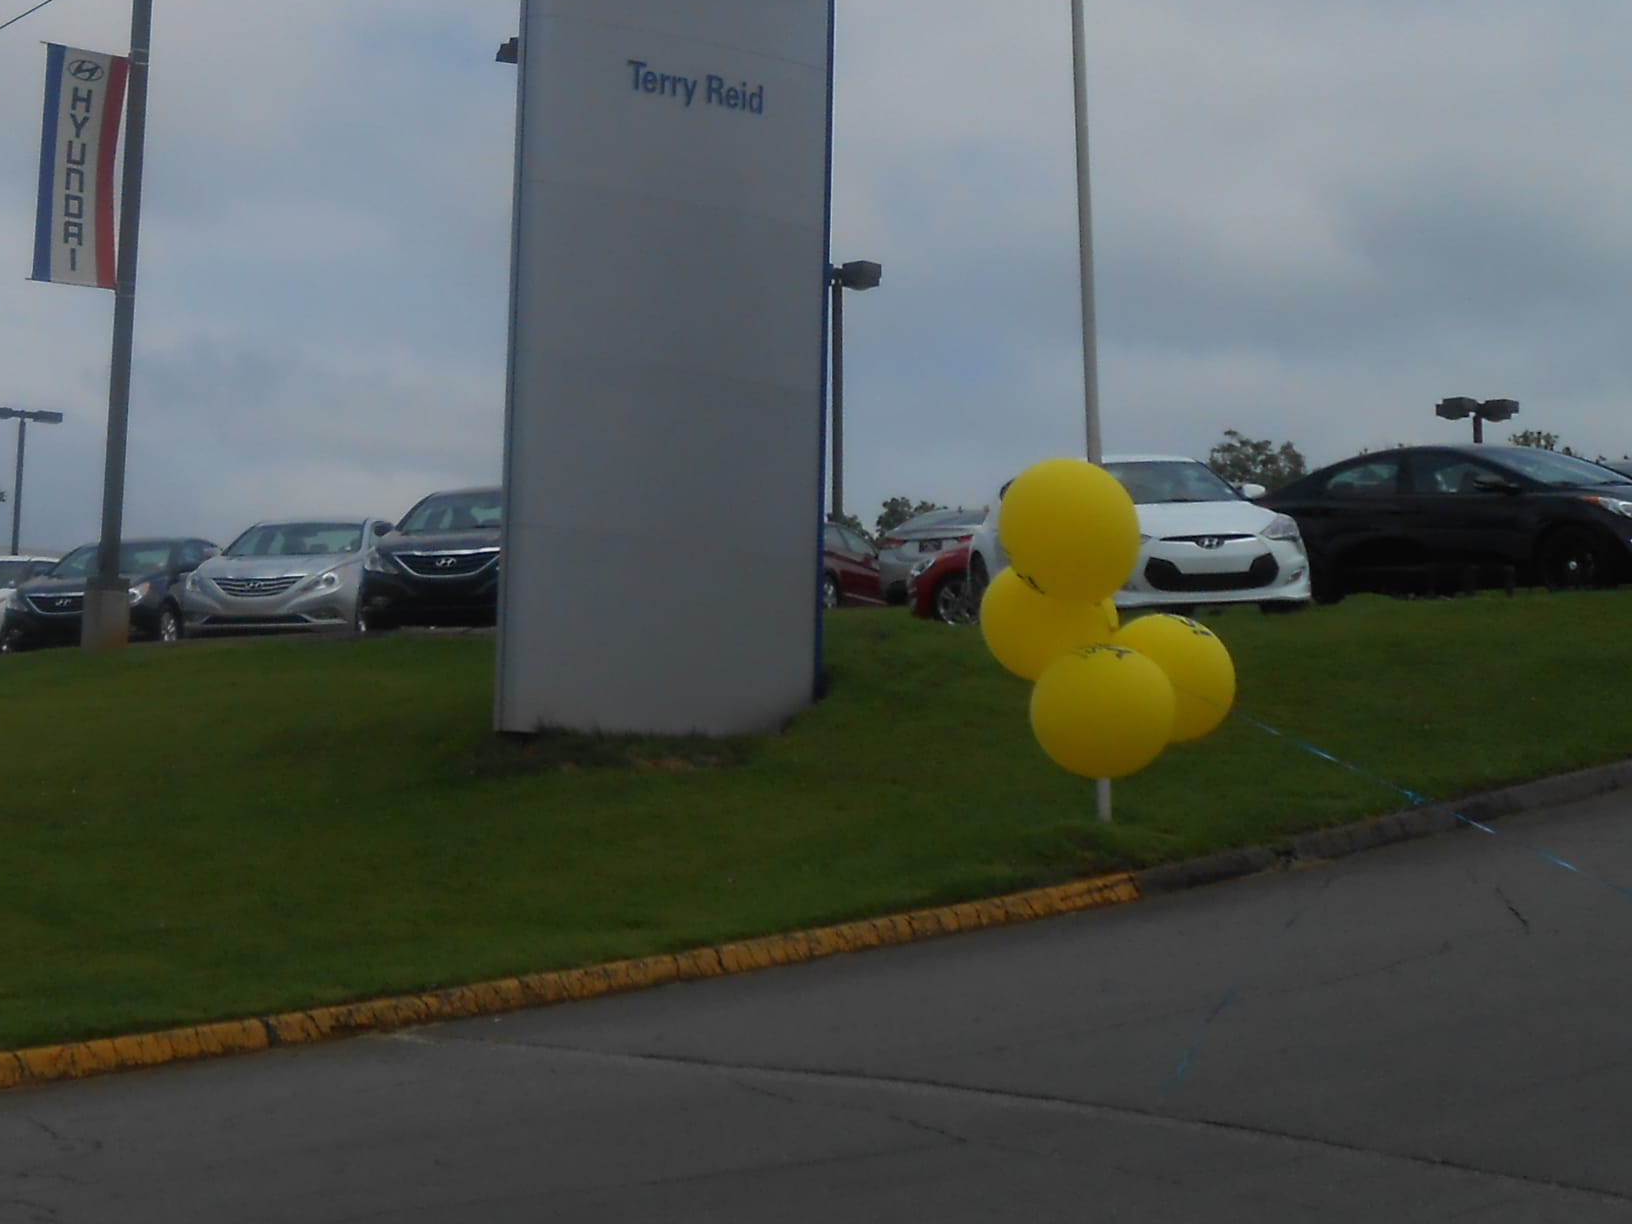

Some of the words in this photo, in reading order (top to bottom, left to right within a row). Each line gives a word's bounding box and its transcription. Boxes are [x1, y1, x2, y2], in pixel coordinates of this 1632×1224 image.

[626, 59, 698, 108] Terry
[705, 74, 764, 115] Reid
[63, 86, 93, 272] HYUNDAI
